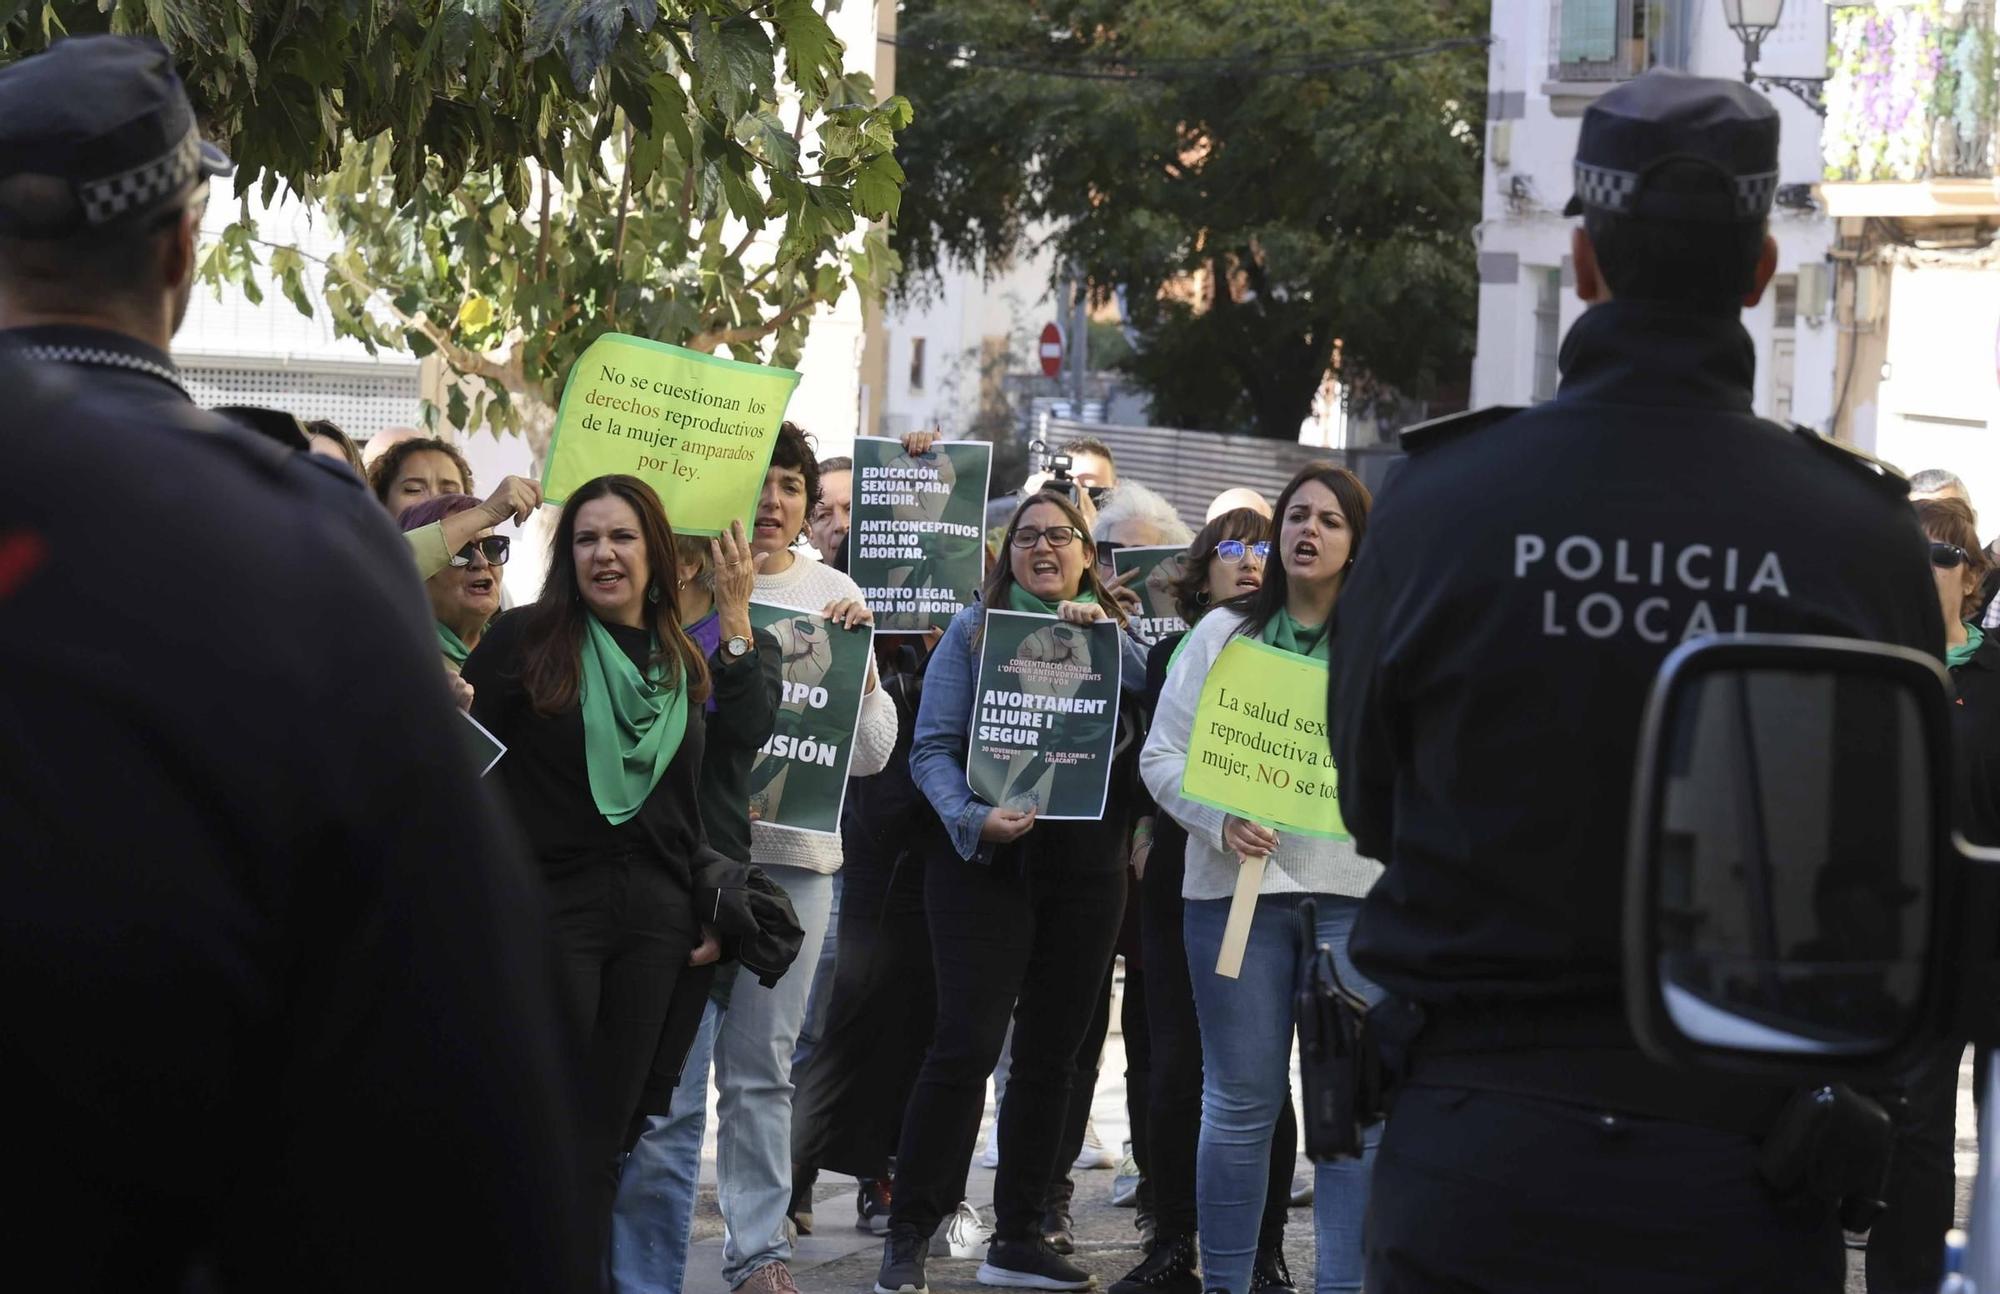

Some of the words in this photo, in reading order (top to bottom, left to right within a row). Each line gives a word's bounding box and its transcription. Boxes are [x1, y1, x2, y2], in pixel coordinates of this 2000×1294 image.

[600, 365, 626, 386] No
[630, 374, 648, 390] se
[653, 380, 741, 412] cuestionan
[747, 397, 767, 415] los
[585, 389, 660, 419] derechos
[665, 408, 765, 439] reproductivos
[582, 413, 602, 433] de
[606, 418, 622, 436] la
[626, 424, 678, 449] mujer
[681, 438, 755, 462] amparados
[637, 453, 668, 472] por
[672, 458, 701, 482] ley.
[862, 466, 939, 480] EDUCACIÓN
[861, 480, 913, 492] SEXUAL
[915, 482, 951, 495] PARA
[861, 493, 920, 507] DECIDIR,
[860, 520, 980, 538] ANTICONCEPTIVOS
[860, 534, 896, 546] PARA
[898, 534, 919, 546] NO
[860, 547, 928, 561] ABORTAR,
[1513, 534, 1790, 598] POLICIA
[915, 588, 956, 601] LEGAL
[896, 601, 916, 613] NO
[1063, 664, 1093, 674] CONTRA
[780, 680, 829, 709] RPO
[983, 690, 1108, 715] AVORTAMENT
[982, 707, 1043, 728] LLIURE
[1046, 714, 1054, 729] I
[1217, 687, 1239, 712] La
[1242, 701, 1290, 728] salud
[1294, 716, 1329, 738] sex
[979, 725, 1040, 746] SEGUR
[1210, 720, 1318, 766] reproductiva
[1201, 749, 1251, 782] mujer,
[1255, 763, 1290, 789] NO
[1294, 779, 1315, 796] se
